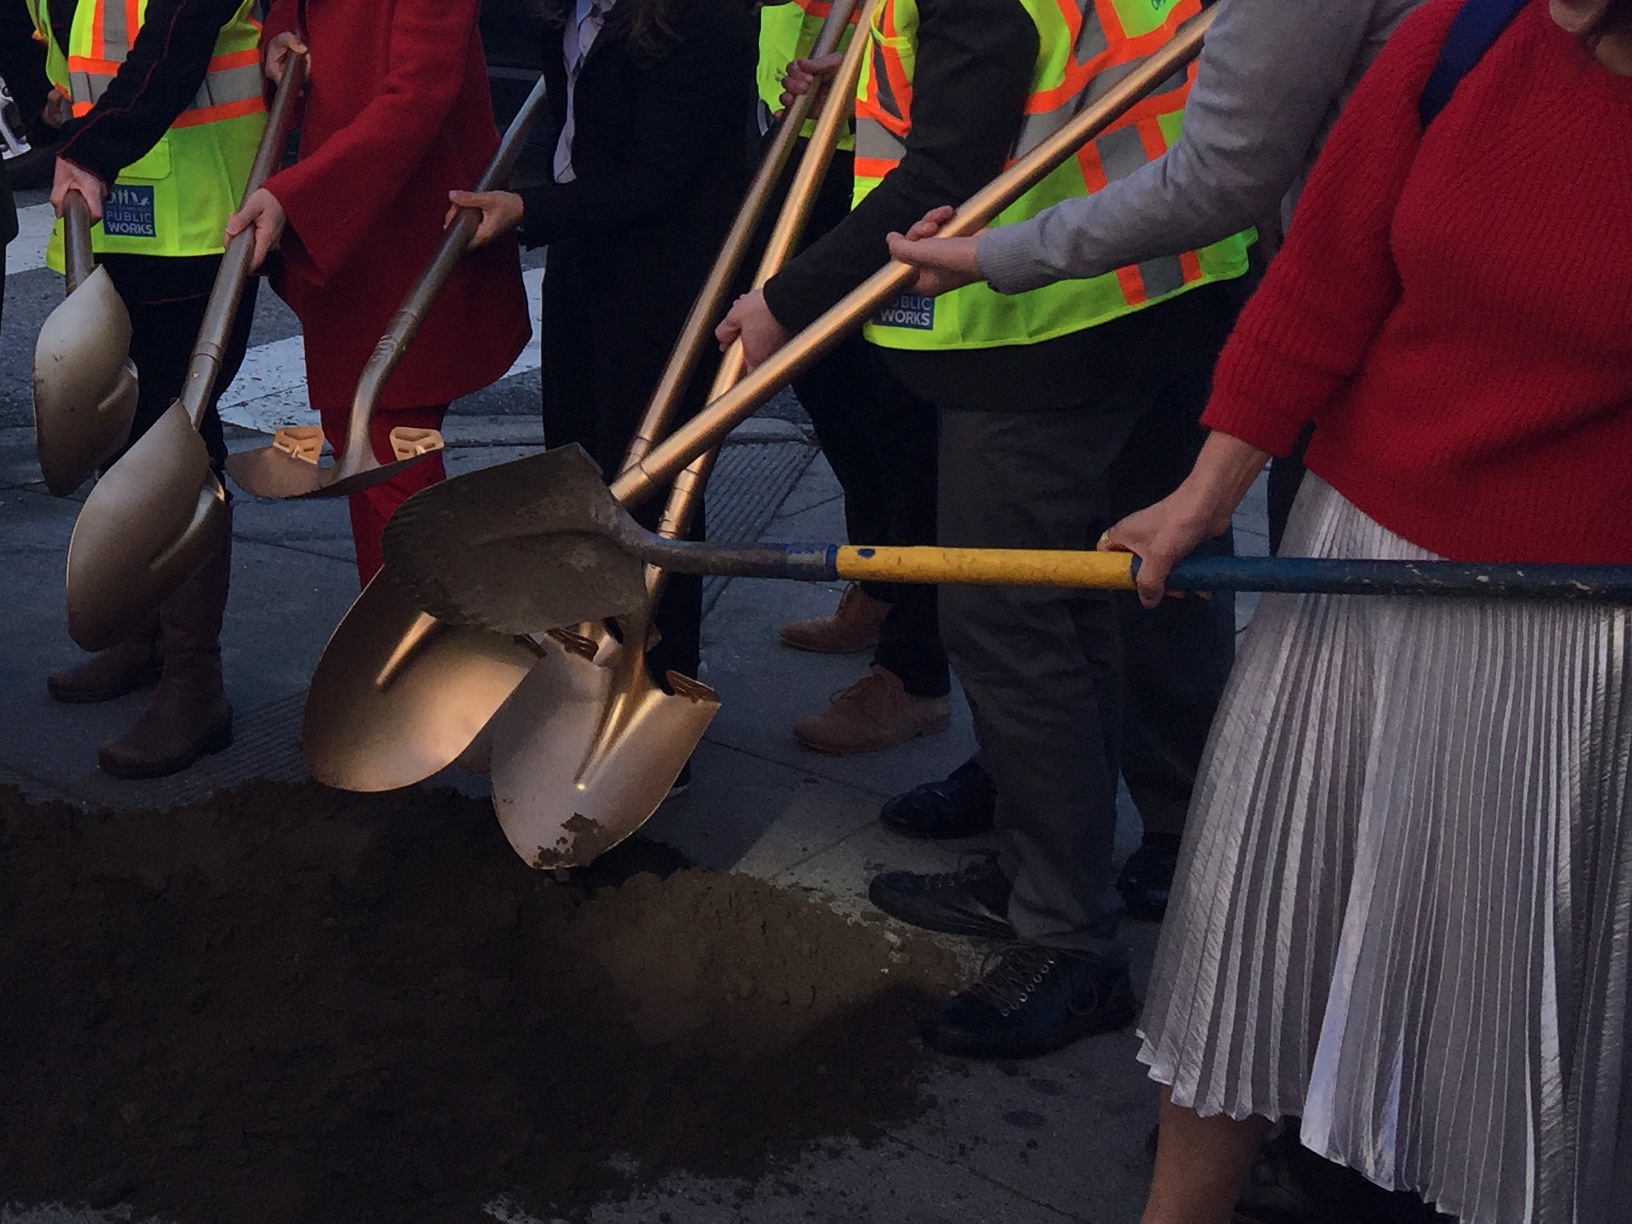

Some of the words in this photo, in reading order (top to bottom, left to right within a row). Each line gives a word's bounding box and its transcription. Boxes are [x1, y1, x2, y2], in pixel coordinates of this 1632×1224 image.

[106, 211, 152, 222] PUBLIC
[108, 222, 154, 234] WORKS
[891, 296, 932, 310] UBLIC
[880, 309, 930, 326] WORKS
